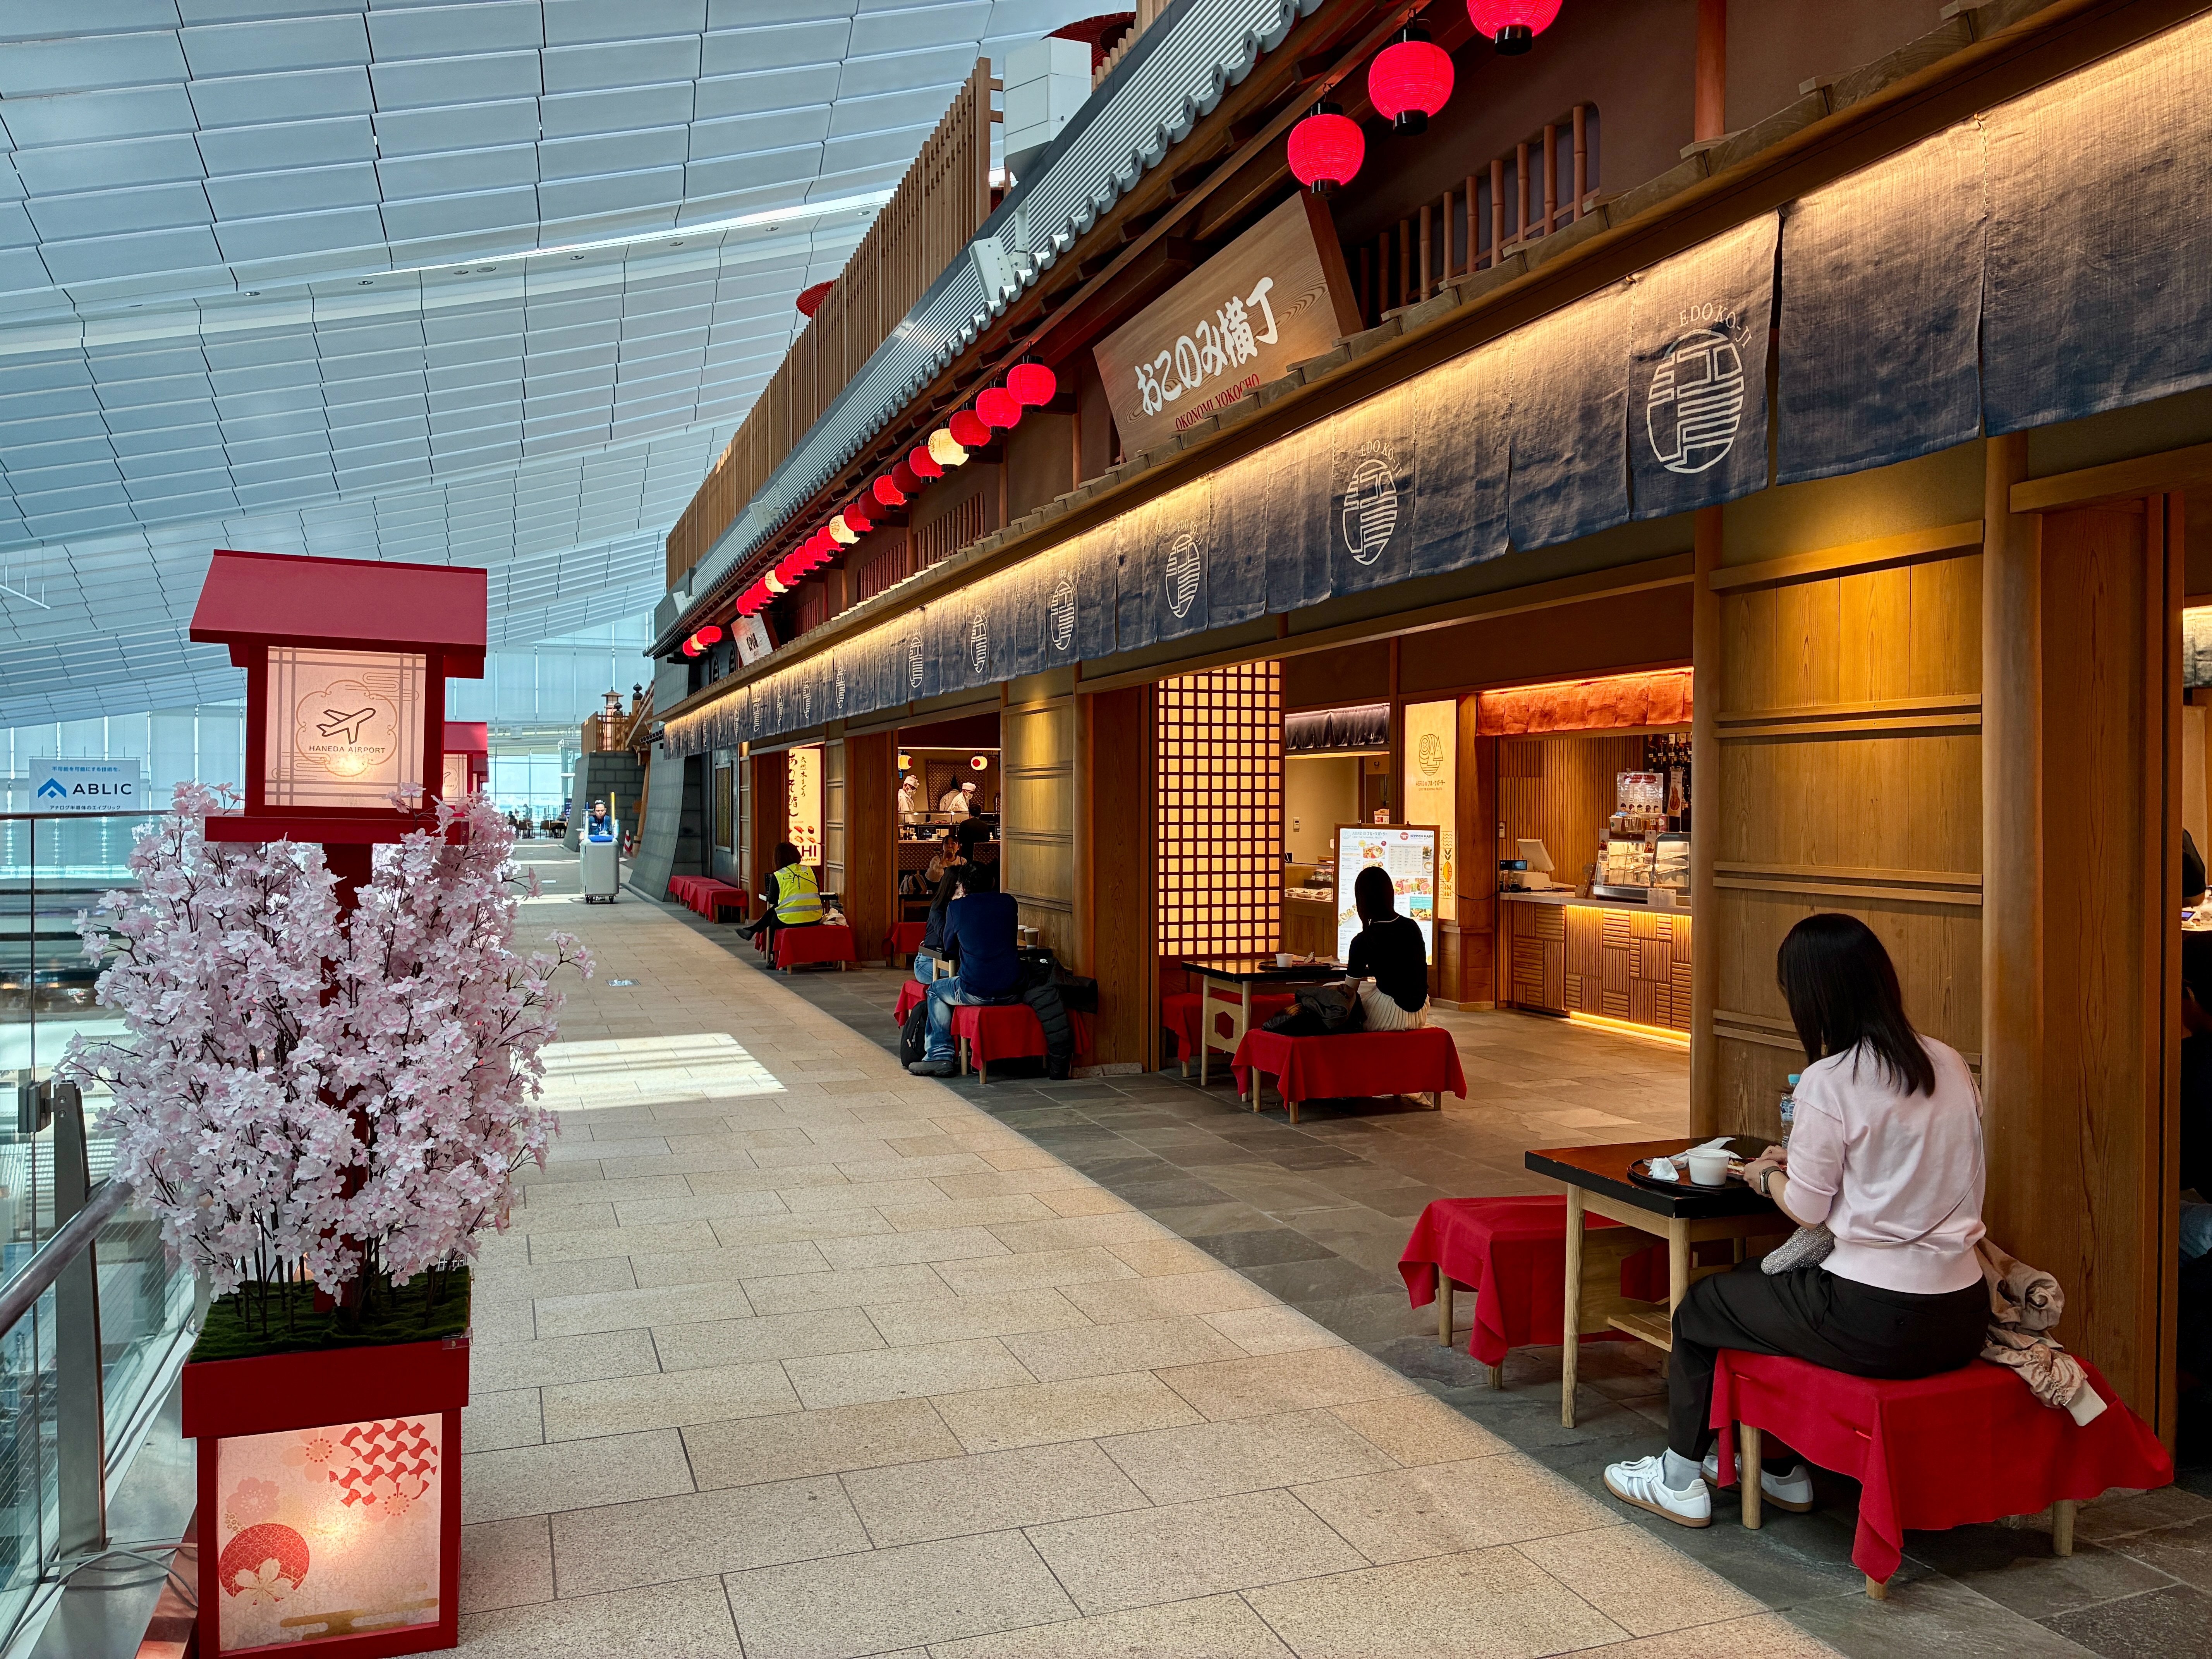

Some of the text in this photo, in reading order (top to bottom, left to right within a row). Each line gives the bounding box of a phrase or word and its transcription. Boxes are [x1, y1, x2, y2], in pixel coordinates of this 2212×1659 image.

[1135, 277, 1278, 416] おこのみ横丁
[1175, 374, 1260, 431] OKONOMI YOKOCHO
[72, 783, 132, 795] ABLIC
